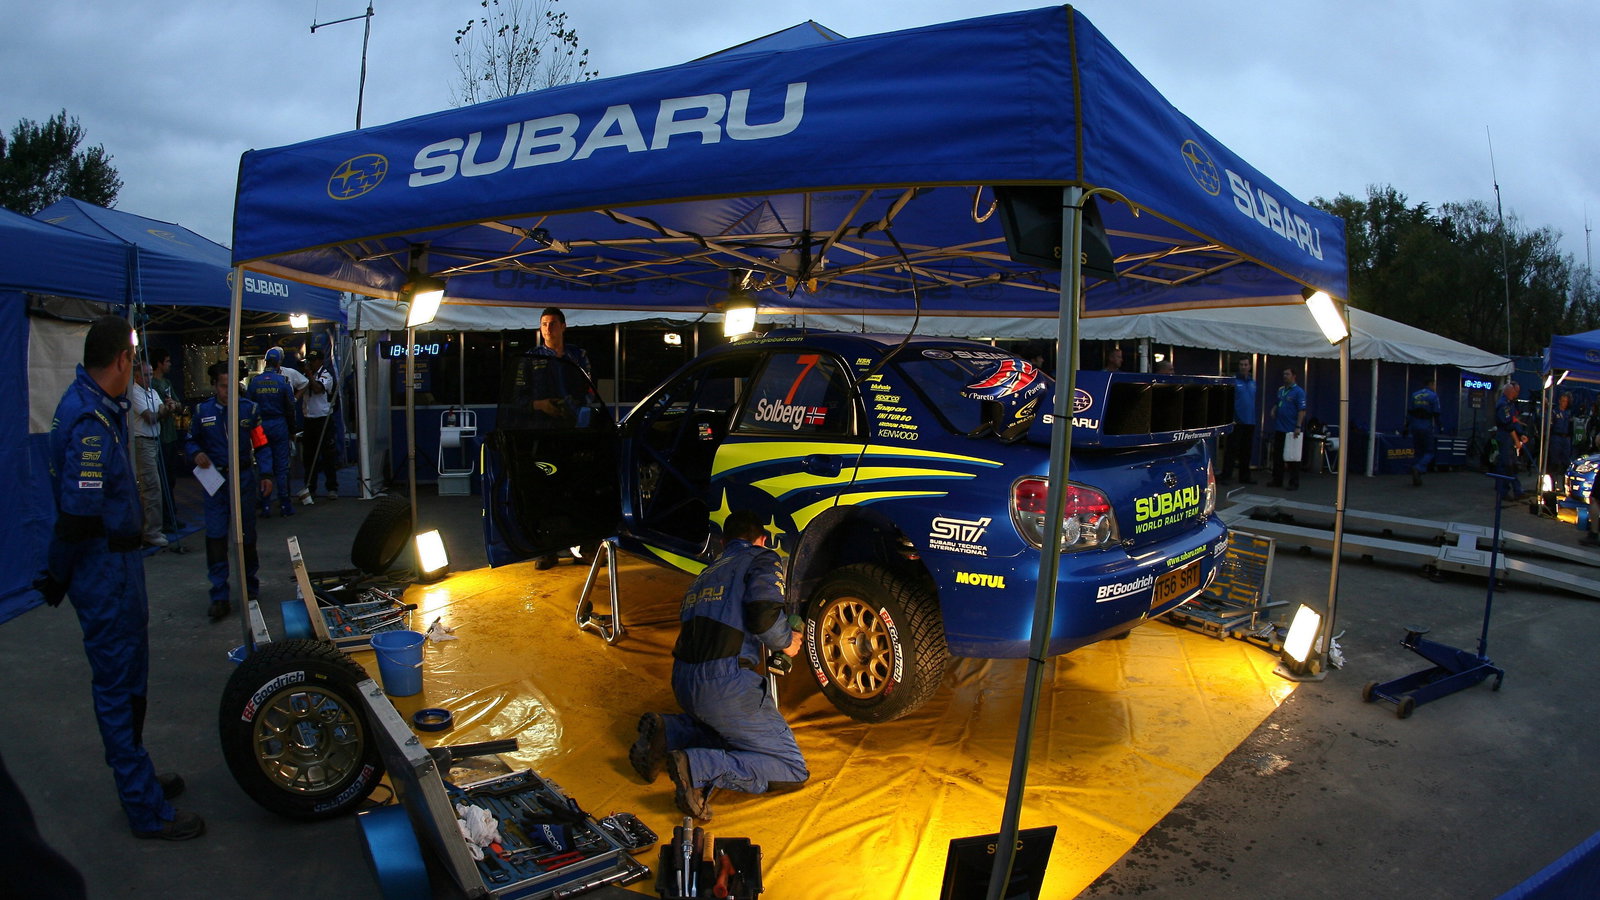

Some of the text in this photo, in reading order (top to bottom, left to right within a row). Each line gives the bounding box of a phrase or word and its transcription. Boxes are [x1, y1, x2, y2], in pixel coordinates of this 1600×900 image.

[408, 82, 808, 187] SUBARU
[1225, 169, 1323, 261] SUBARU
[245, 277, 289, 298] SUBARU
[784, 354, 821, 405] 7
[1464, 379, 1491, 389] 18:28:40
[754, 398, 807, 430] Solberg
[878, 429, 918, 440] KENWOOD
[1172, 431, 1212, 442] STI Performance
[80, 470, 103, 478] MOTUL
[1135, 485, 1200, 522] SUBARU
[1135, 507, 1199, 534] WORLD RALLY TEAM
[929, 539, 988, 551] SUBARU TECNICA
[929, 544, 988, 556] INTERNATIONAL
[956, 571, 1006, 589] MOTUL
[1097, 574, 1154, 599] BFGoodrich
[1180, 565, 1199, 588] SRT
[807, 619, 829, 686] BFGoodrich
[880, 610, 903, 683] BFGoodrich
[242, 672, 304, 721] BFGoodrich
